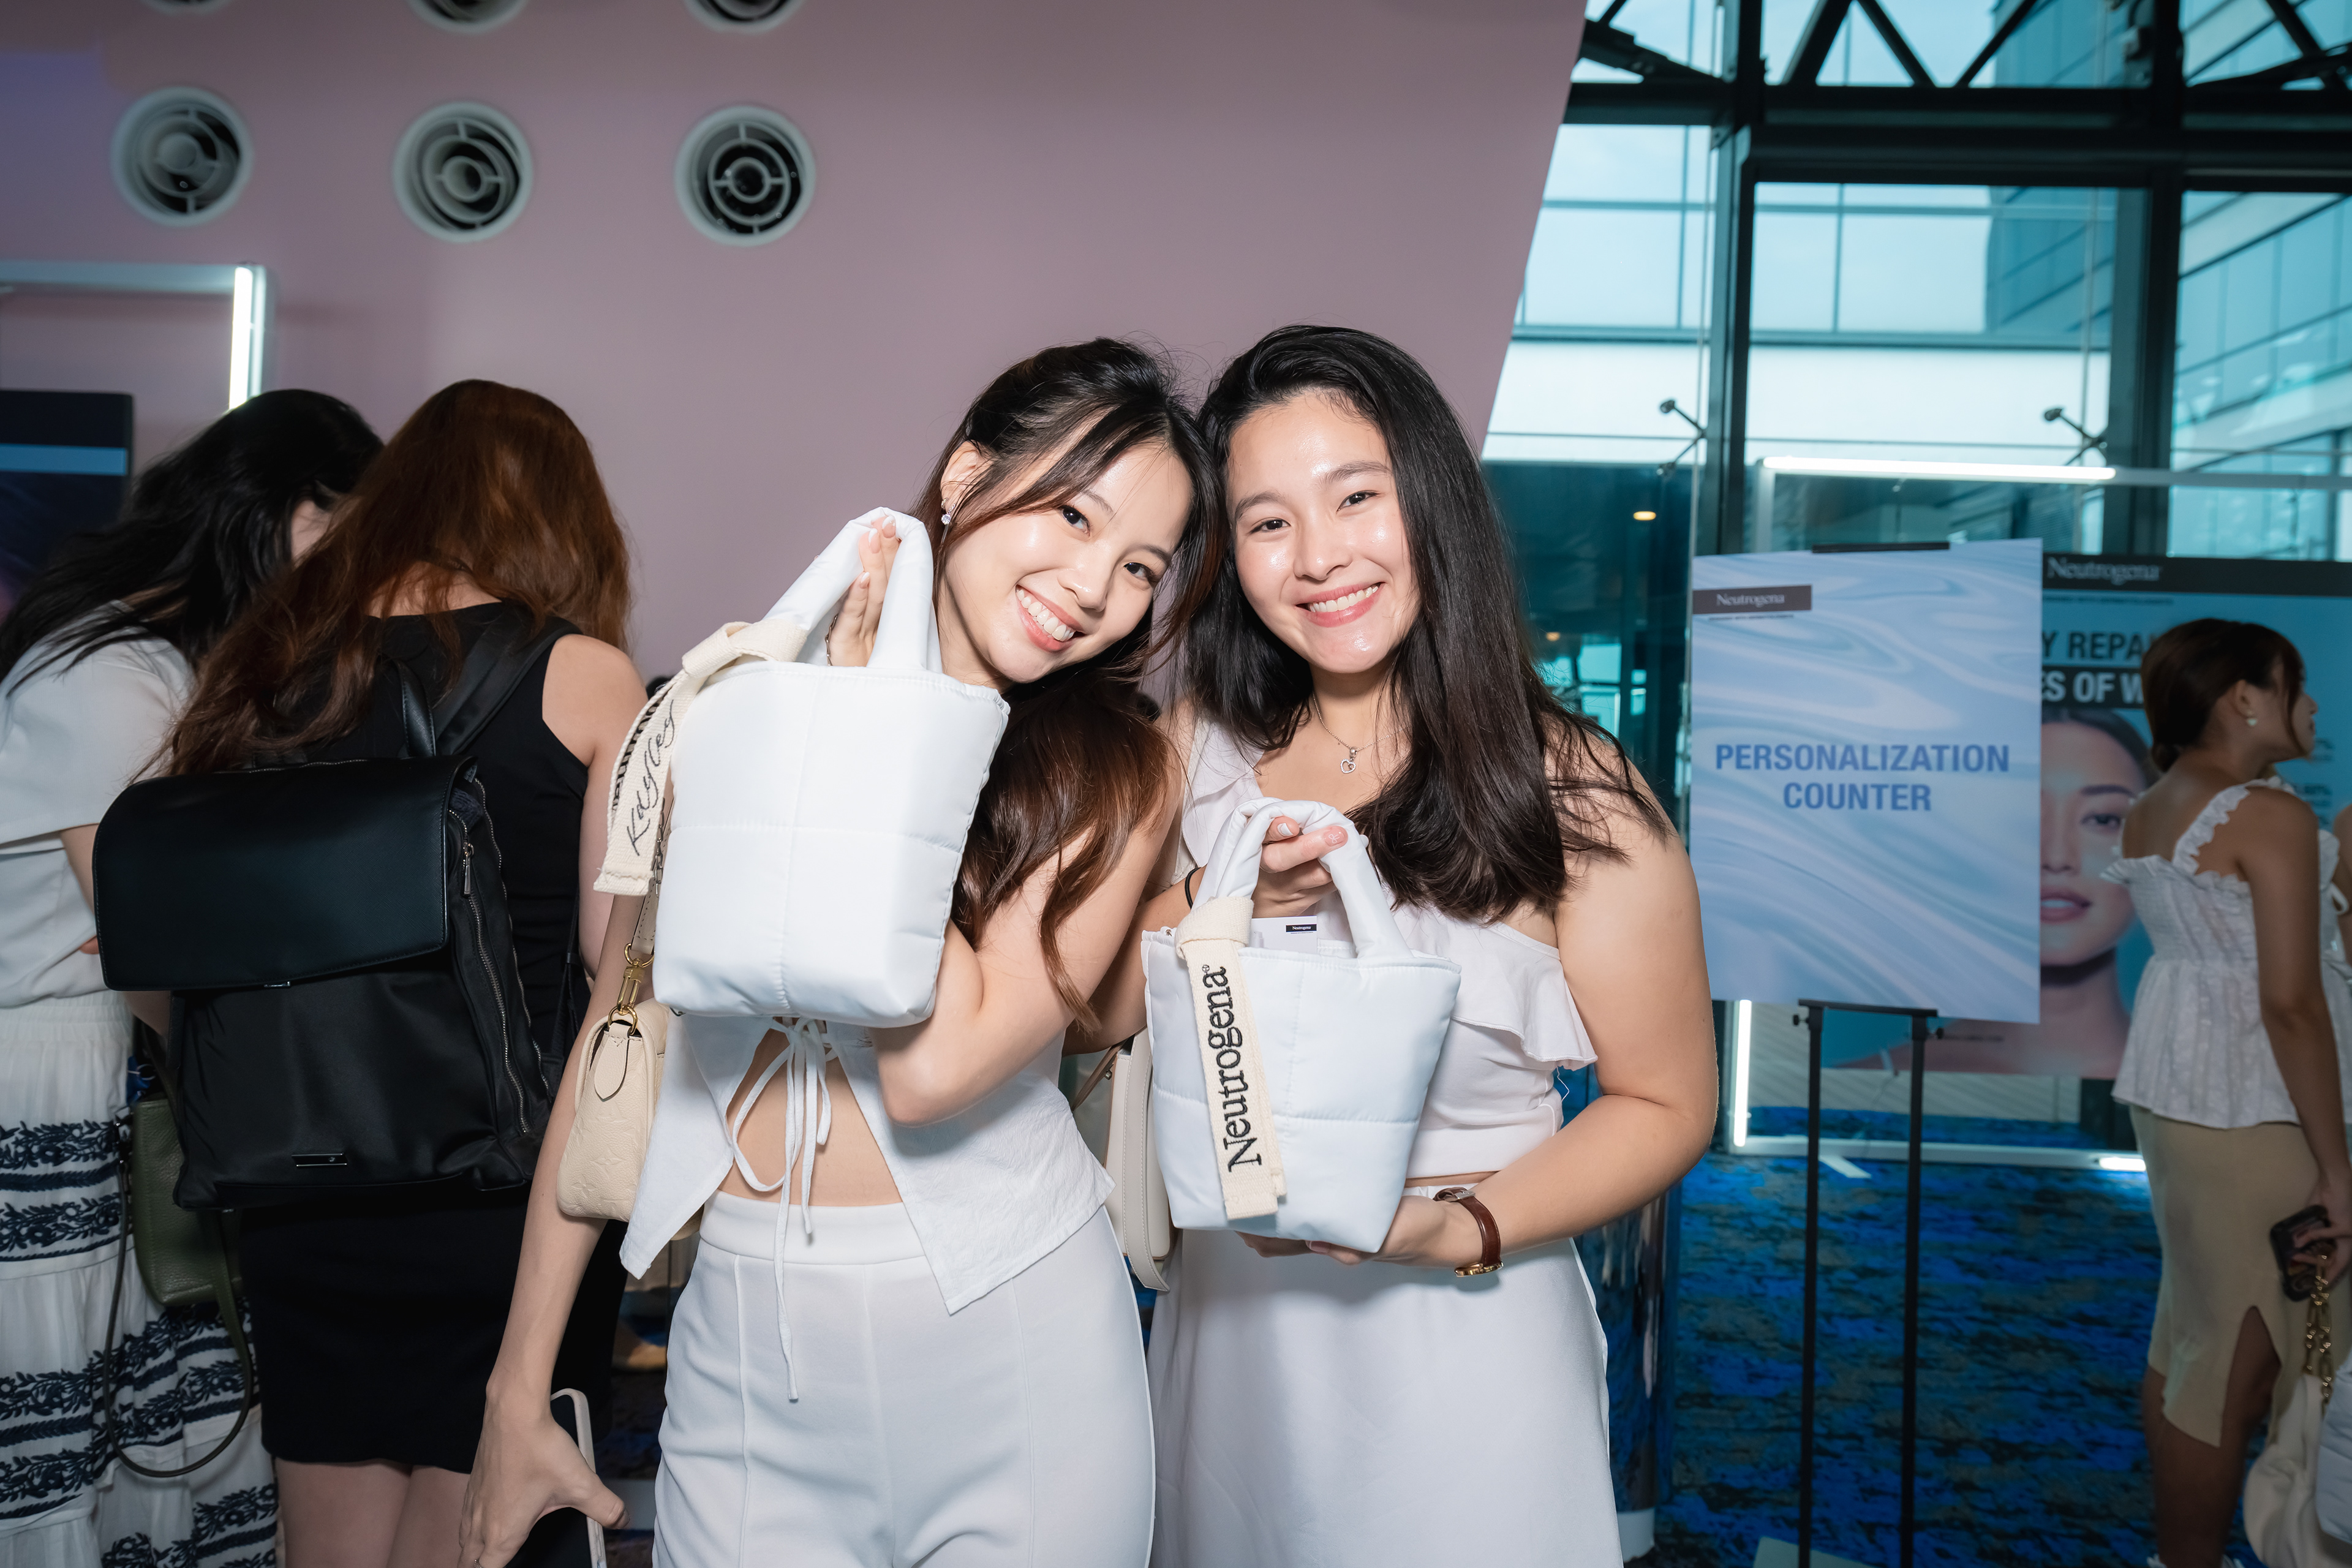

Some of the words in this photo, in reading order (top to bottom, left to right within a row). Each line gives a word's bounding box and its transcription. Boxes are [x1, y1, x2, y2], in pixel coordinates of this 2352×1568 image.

[1716, 594, 1785, 608] Neutrogena
[2068, 631, 2157, 660] REPA
[2073, 671, 2116, 704] OF
[1716, 744, 2009, 772] PERSONALIZATION
[1784, 782, 1931, 811] COUNTER
